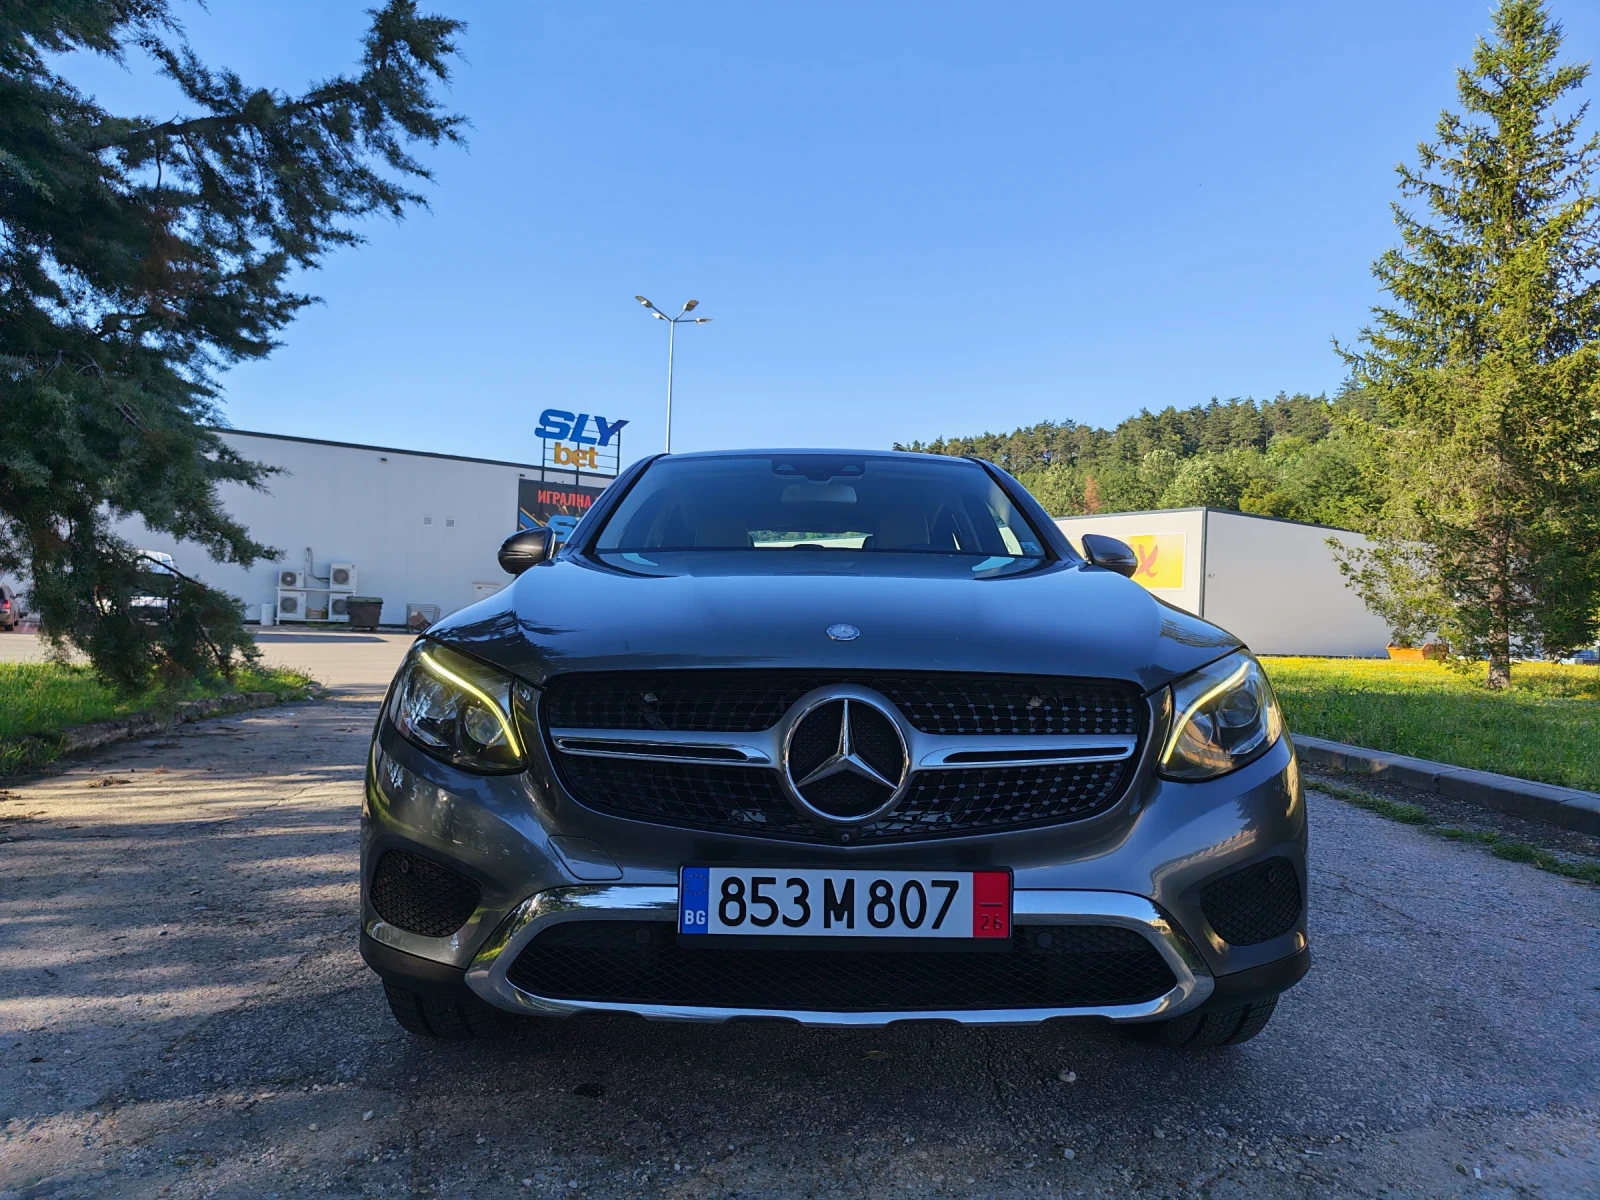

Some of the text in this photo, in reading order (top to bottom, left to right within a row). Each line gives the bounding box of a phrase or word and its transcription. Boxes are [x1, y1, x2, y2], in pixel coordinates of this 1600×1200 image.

[535, 409, 630, 446] SLY
[554, 442, 598, 468] bet
[538, 490, 591, 507] ИГРАЛНА
[718, 876, 960, 930] 853 M 807
[684, 909, 706, 925] BG
[981, 913, 1004, 931] 26
